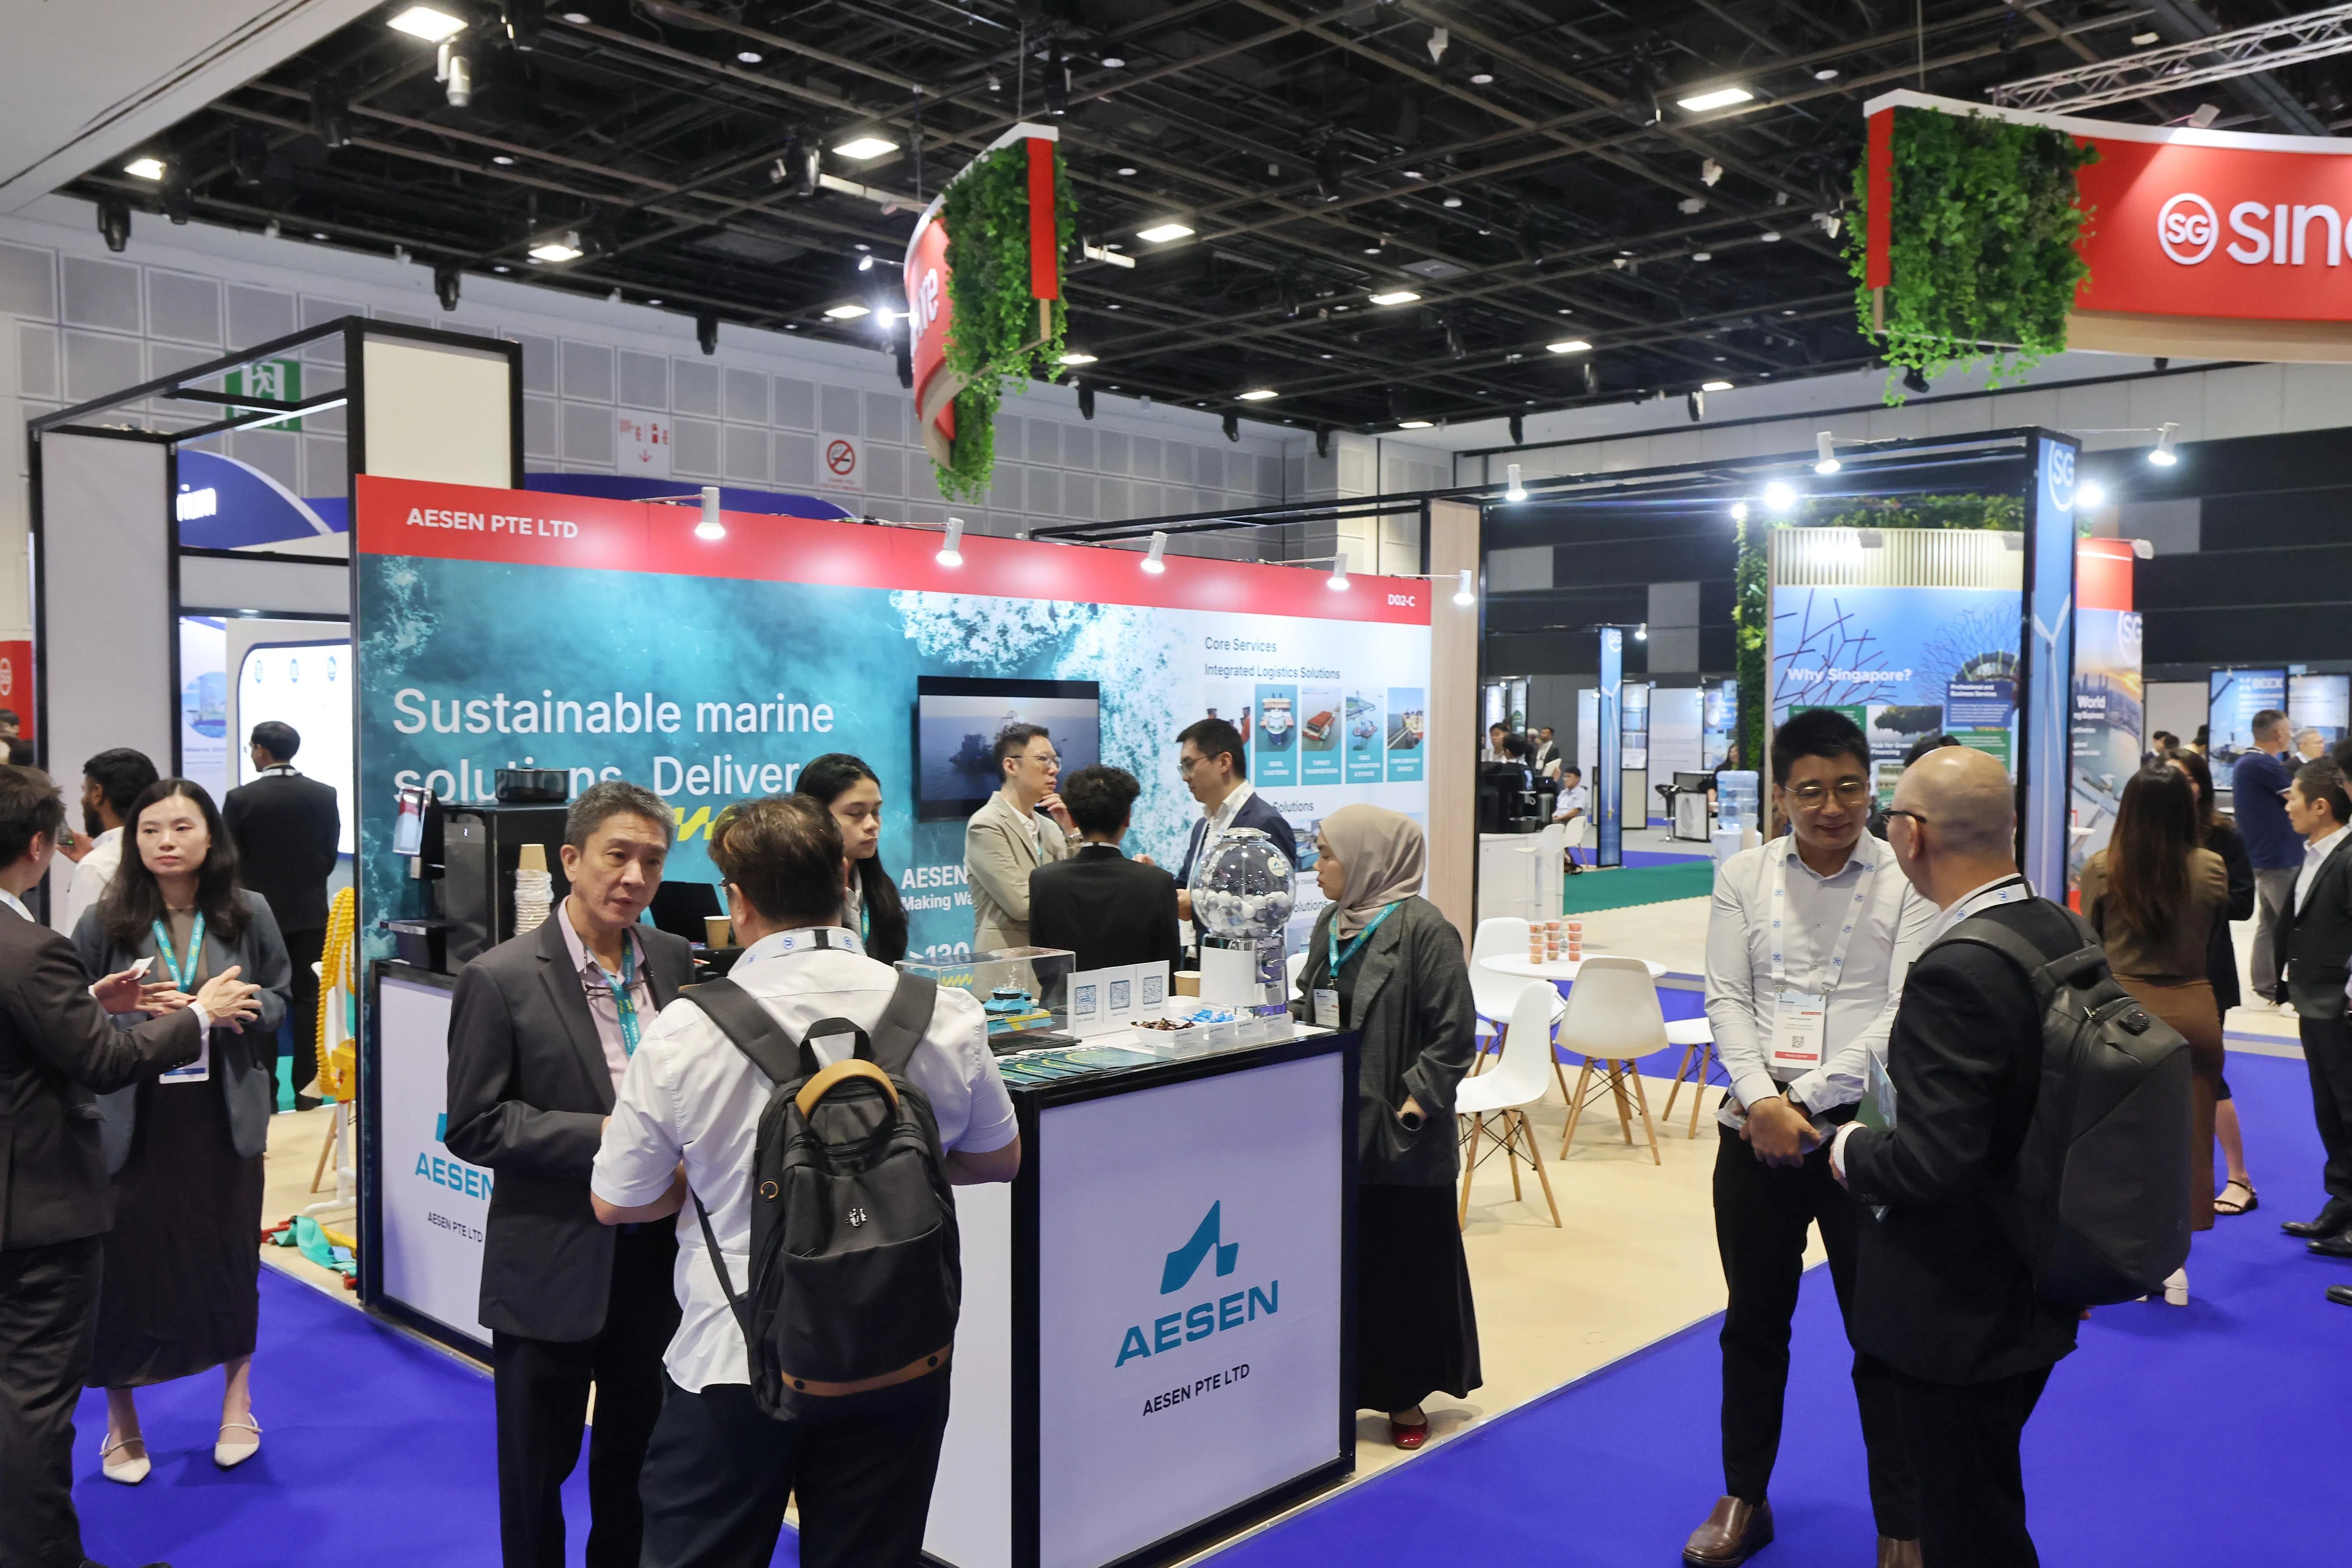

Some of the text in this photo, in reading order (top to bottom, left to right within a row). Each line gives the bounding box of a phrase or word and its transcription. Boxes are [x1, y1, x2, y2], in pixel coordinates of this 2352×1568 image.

[406, 508, 578, 539] AESEN PTE LTD
[1388, 594, 1415, 607] D02-C
[1205, 637, 1277, 653] Core Services
[1205, 663, 1341, 680] Integrated Logistics Solutions
[1788, 668, 1912, 685] Why Singapore?
[393, 688, 834, 735] Sustainable marine
[1273, 801, 1314, 813] Solutions
[900, 865, 968, 889] AESEN
[900, 893, 951, 911] Making
[1293, 899, 1327, 912] olutions
[414, 1152, 494, 1201] AESEN
[428, 1212, 483, 1243] AESEN PTE LTD
[1115, 1280, 1278, 1368] AESEN
[1142, 1363, 1250, 1416] AESEN PTE LTD
